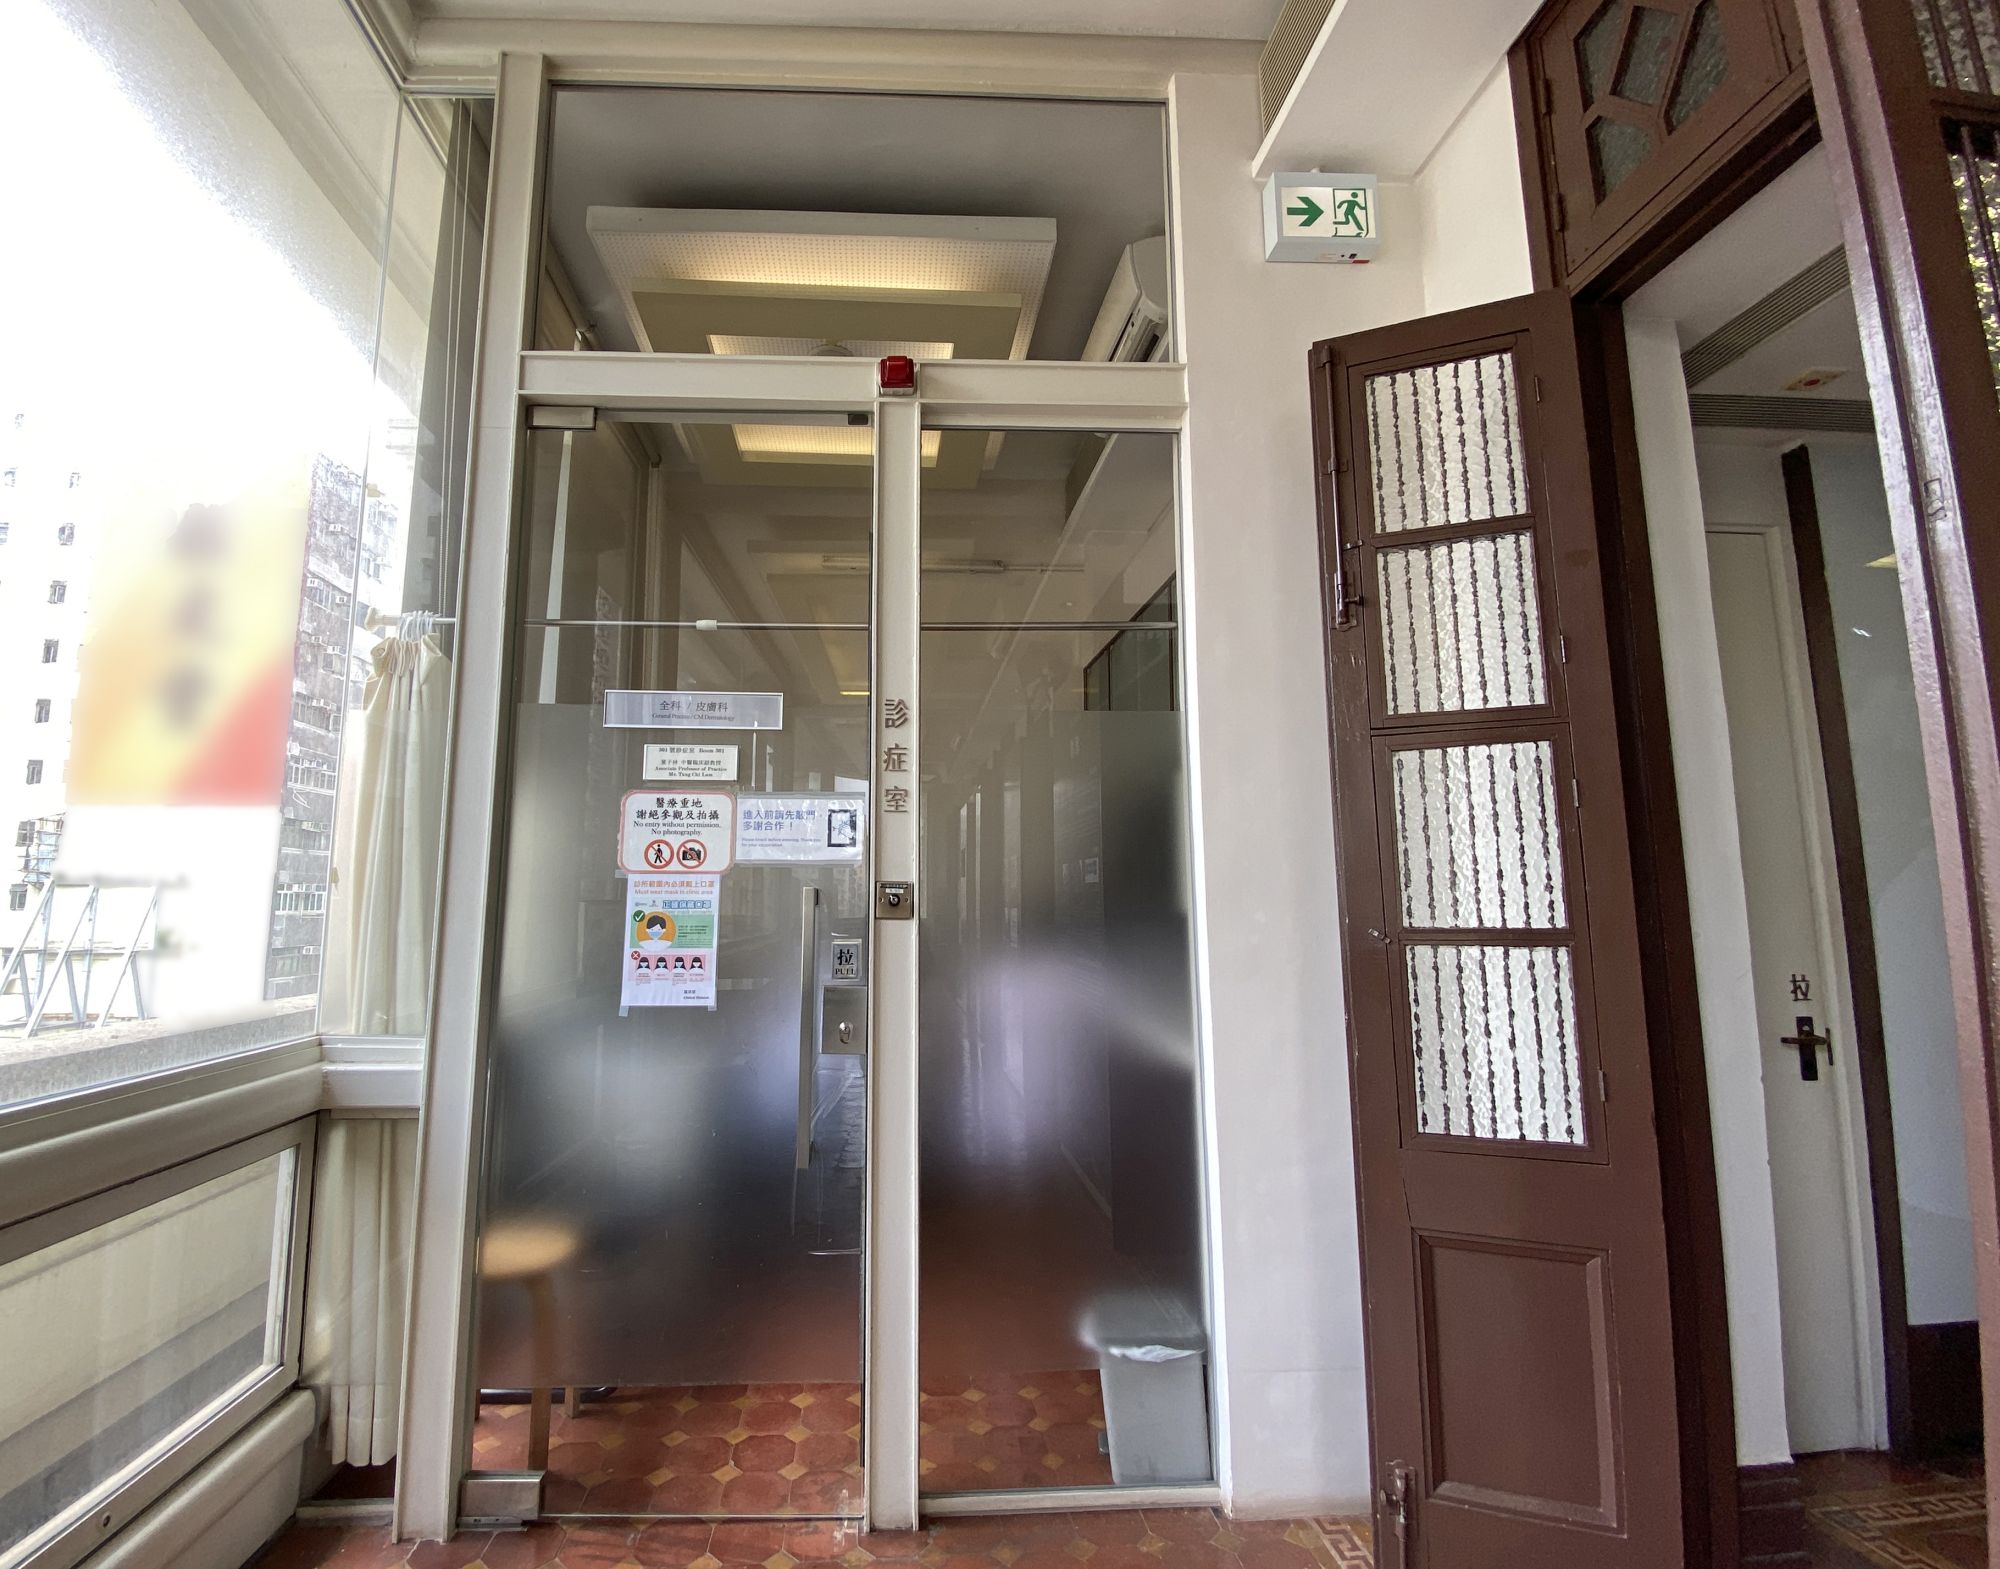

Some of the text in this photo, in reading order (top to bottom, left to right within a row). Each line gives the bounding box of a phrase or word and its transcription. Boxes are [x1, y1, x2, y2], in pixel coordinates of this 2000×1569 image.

[659, 700, 681, 711] 全科
[695, 701, 729, 713] 皮膚科
[883, 698, 909, 813] 診症室
[656, 797, 703, 808] 醫療重地
[635, 809, 720, 821] 謝絕參觀及拍攝
[644, 821, 661, 829] entry
[686, 821, 722, 829] permission.
[662, 828, 703, 837] photography.
[837, 948, 854, 966] 拉
[1789, 973, 1812, 1002] 拉
